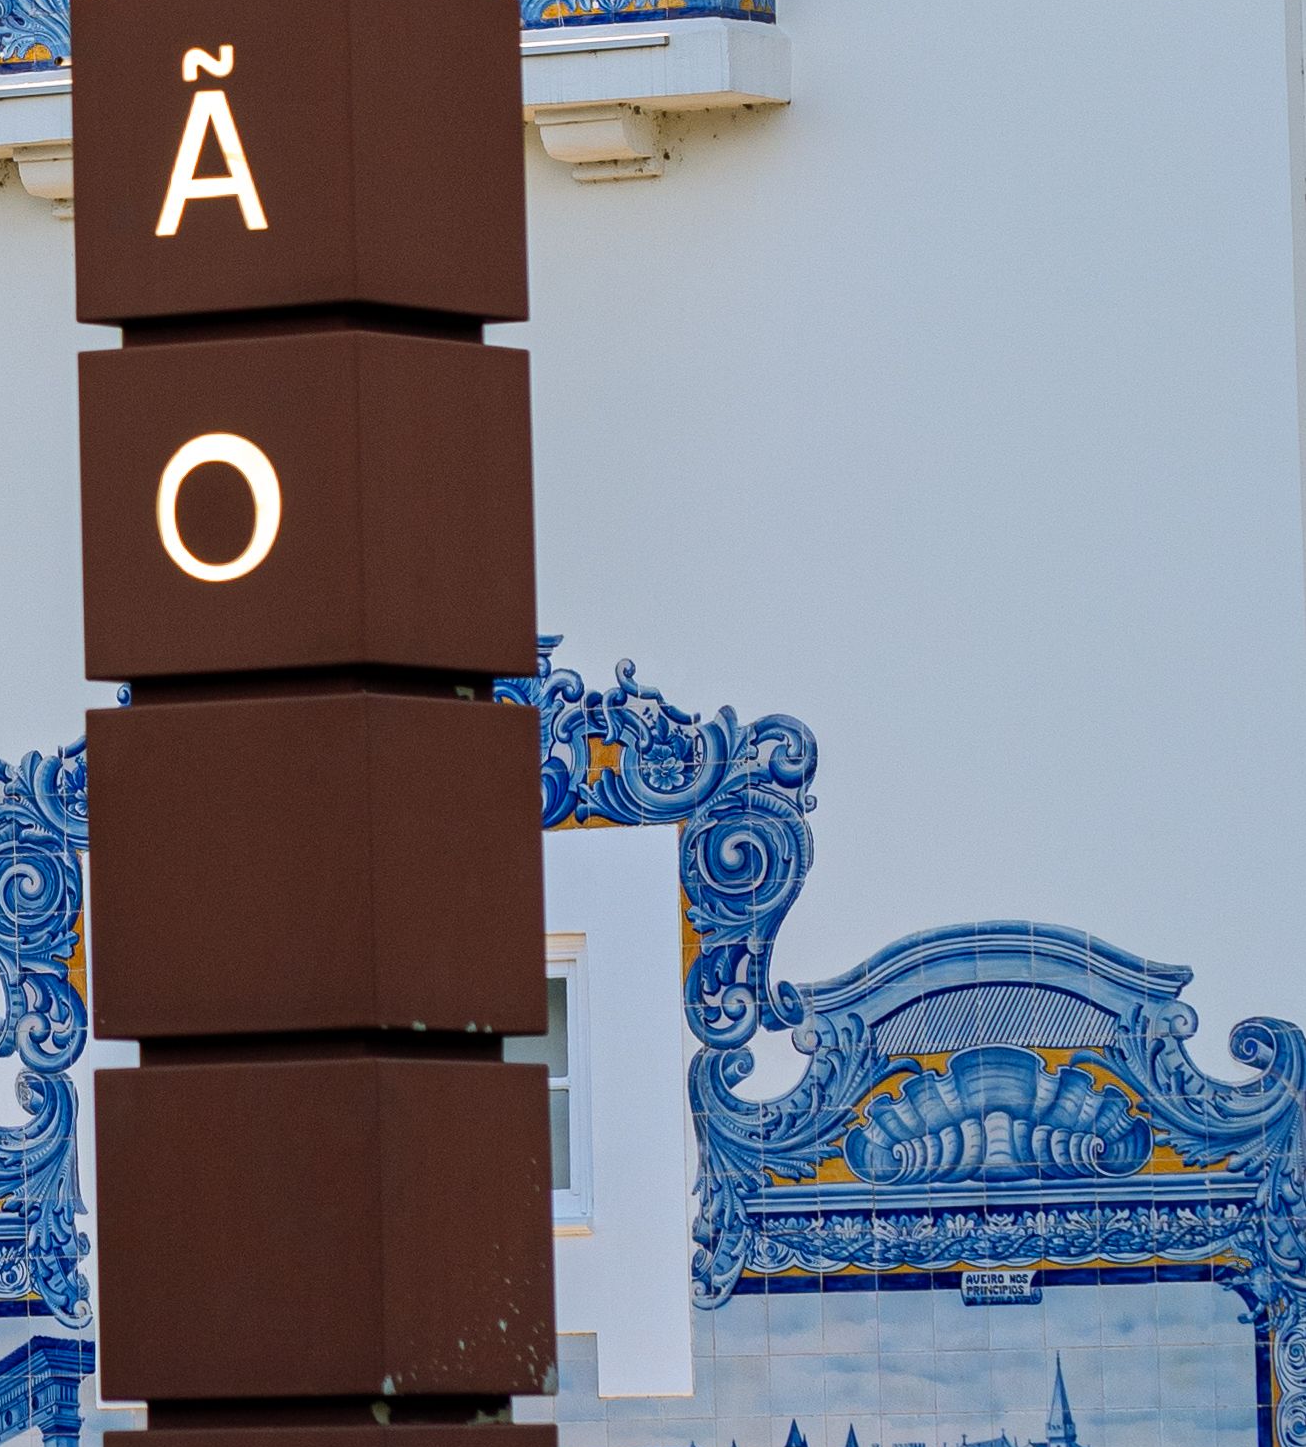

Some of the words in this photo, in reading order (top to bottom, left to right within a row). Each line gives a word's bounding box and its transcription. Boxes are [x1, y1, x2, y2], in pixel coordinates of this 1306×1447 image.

[966, 1273, 1004, 1285] AVEIRO
[1009, 1273, 1029, 1284] NOS
[967, 1285, 1025, 1296] PRINCIPIOS
